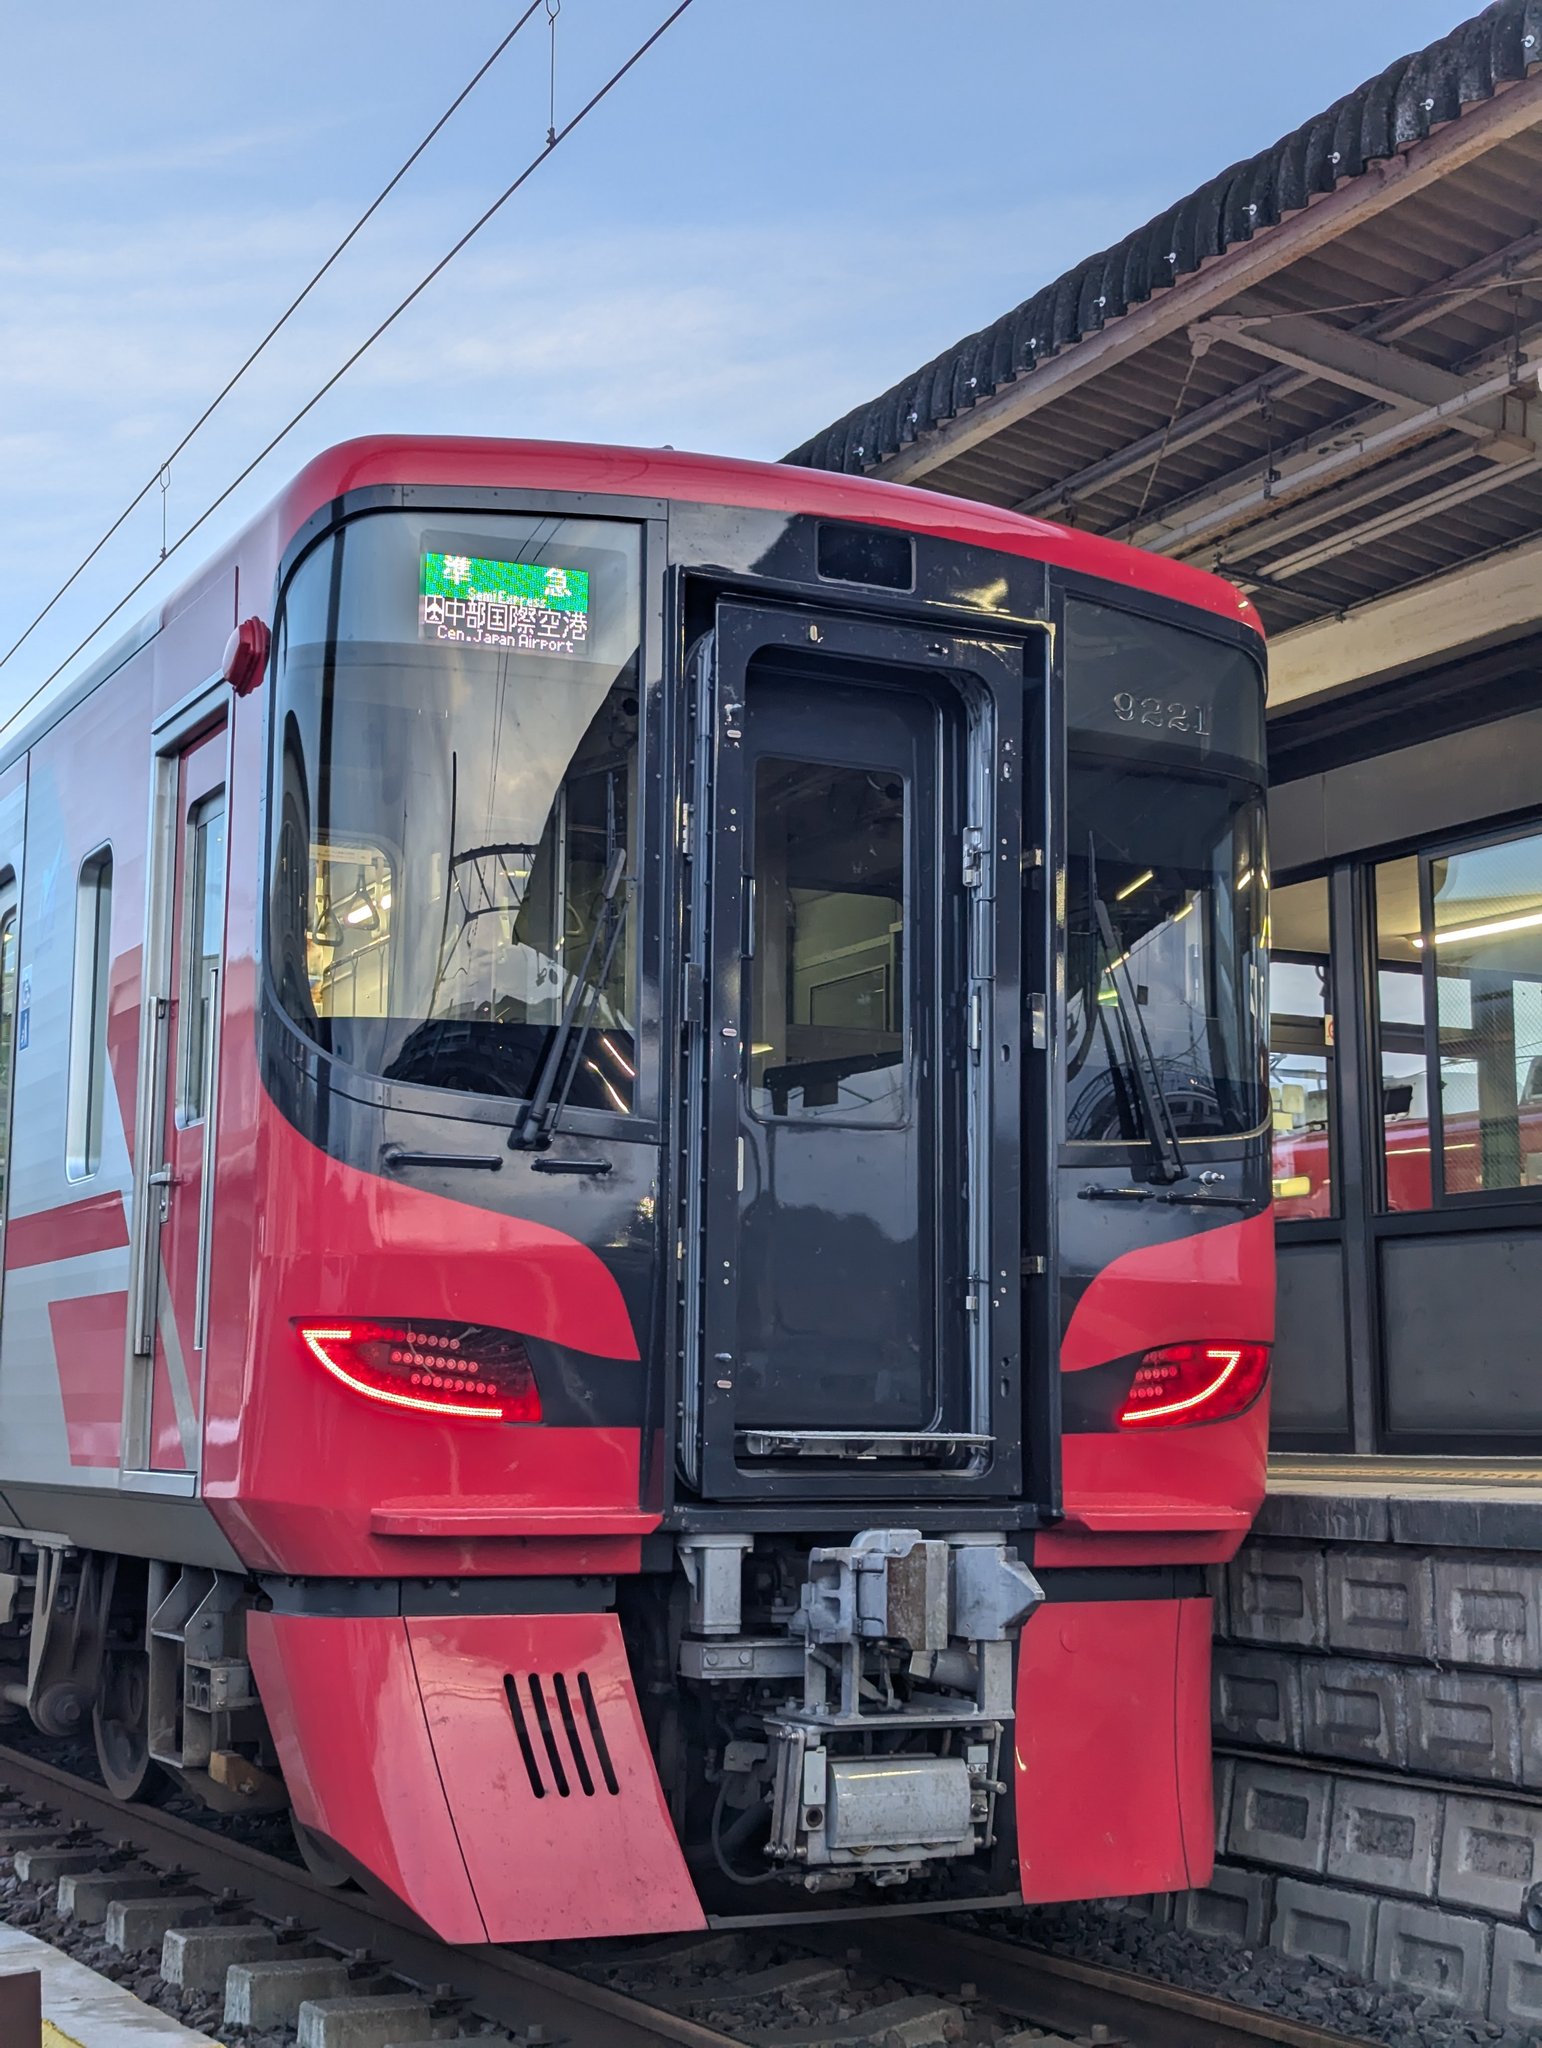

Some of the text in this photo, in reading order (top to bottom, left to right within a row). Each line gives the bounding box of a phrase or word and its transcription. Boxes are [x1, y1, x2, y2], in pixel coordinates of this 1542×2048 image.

[443, 555, 572, 597] 準急
[445, 597, 588, 641] 中部国際空港
[518, 634, 574, 653] Airport
[1113, 692, 1210, 736] 9221
